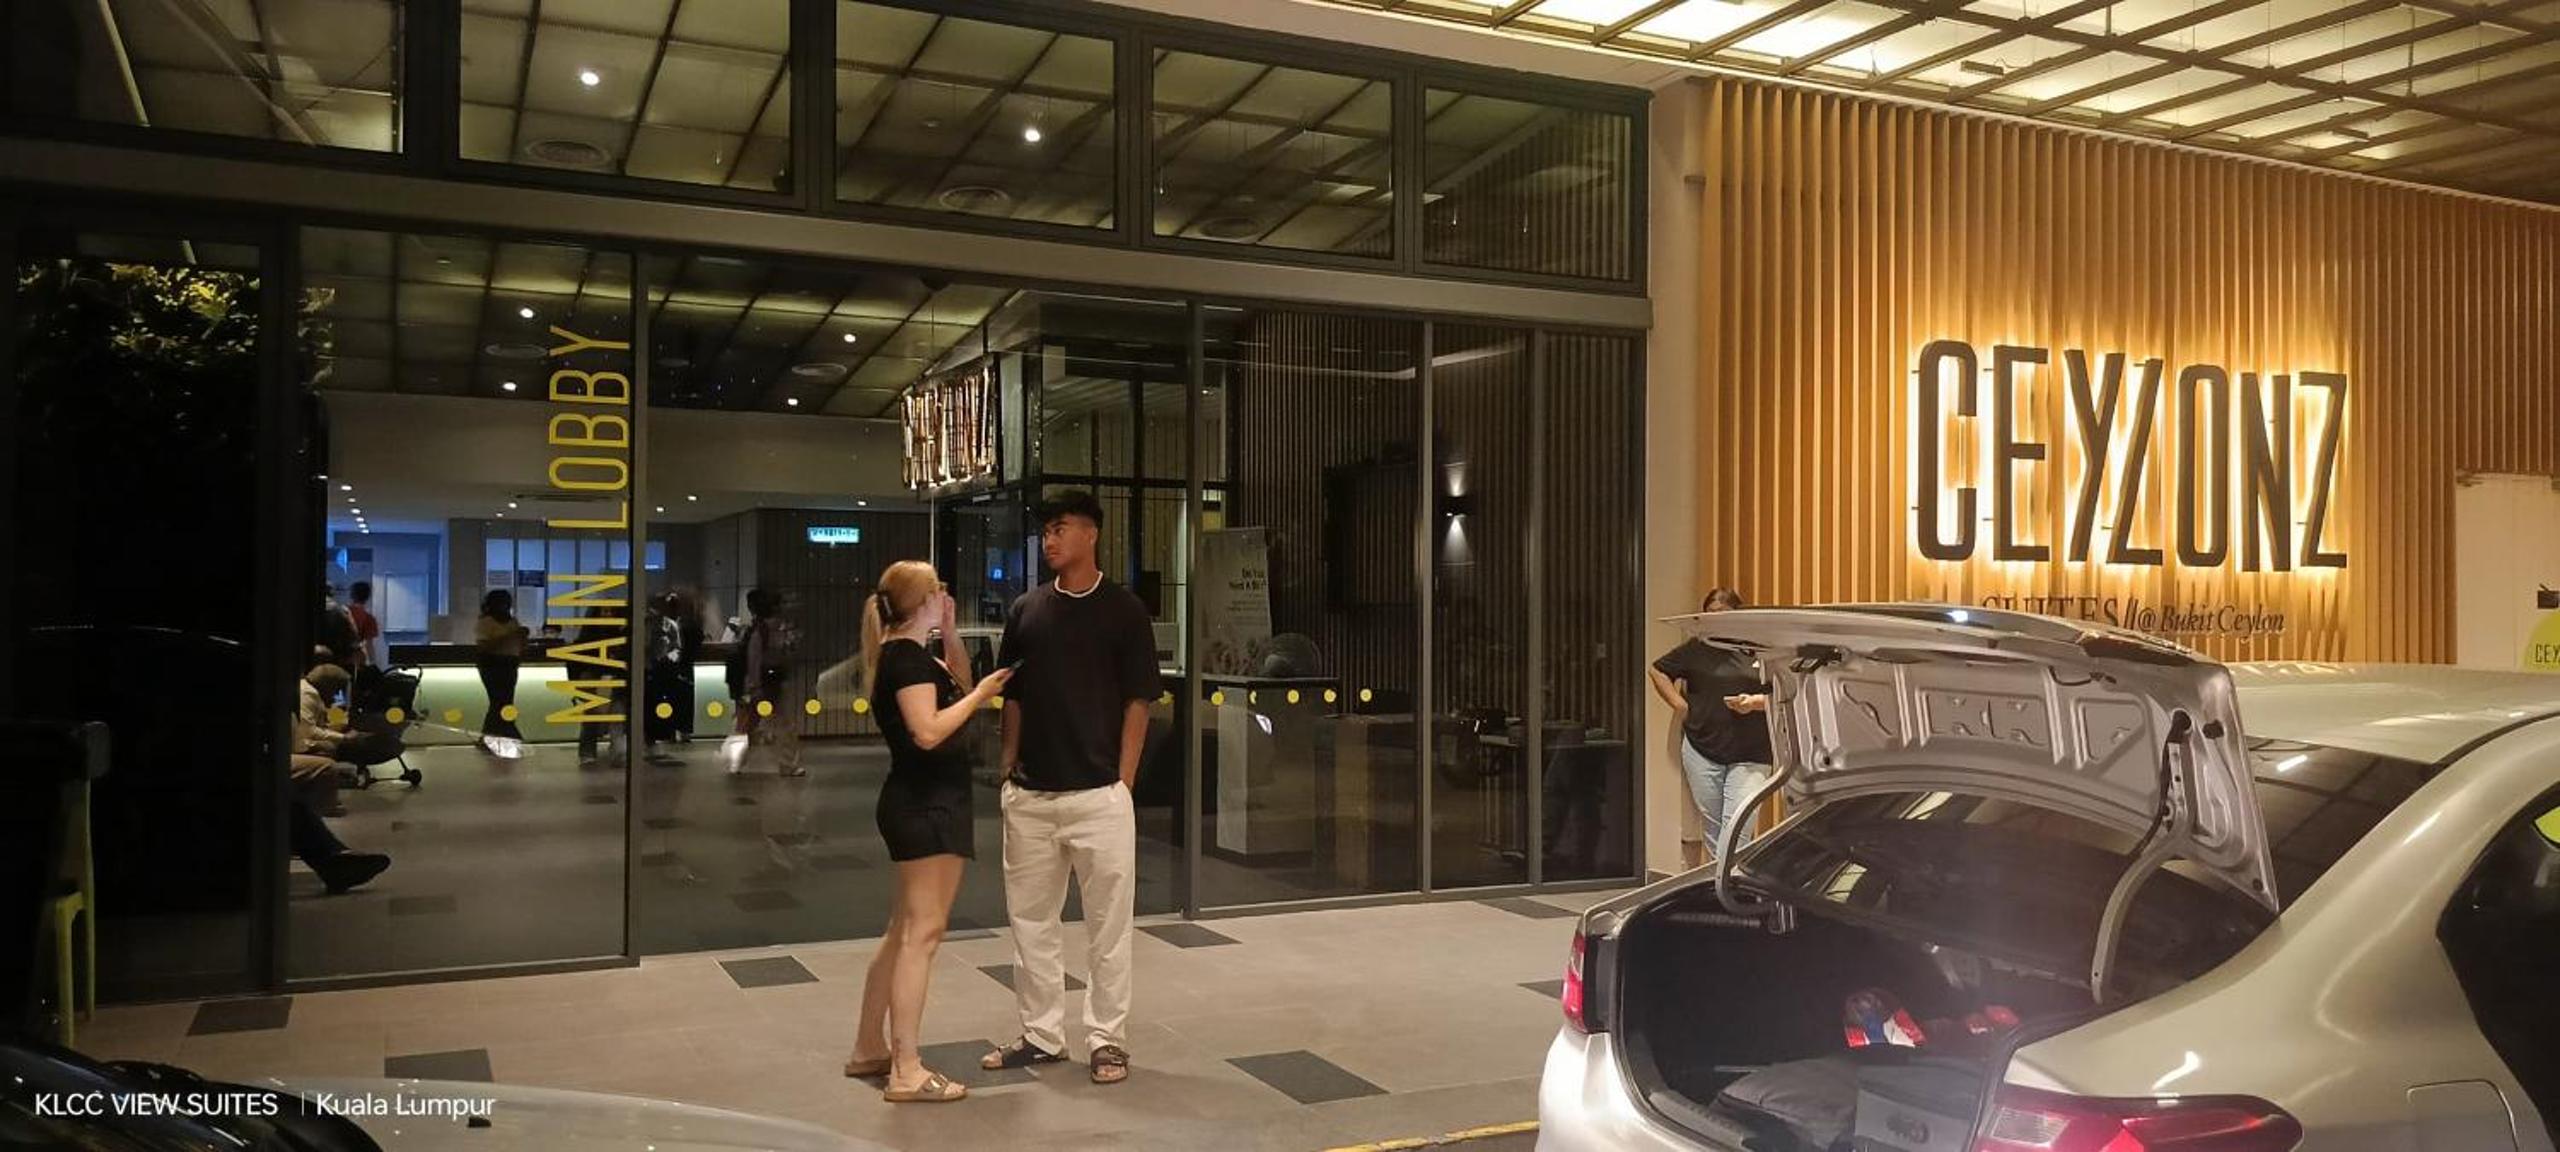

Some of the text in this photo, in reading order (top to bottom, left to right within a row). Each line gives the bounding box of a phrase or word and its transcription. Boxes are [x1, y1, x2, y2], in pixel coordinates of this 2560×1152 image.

[545, 325, 631, 723] MAIN LOBBY
[1918, 340, 2347, 572] CEYLONZ
[1982, 596, 2118, 627] TES
[2161, 603, 2215, 632] Bukit
[2217, 603, 2285, 640] Ceylon
[2535, 643, 2560, 663] CEY
